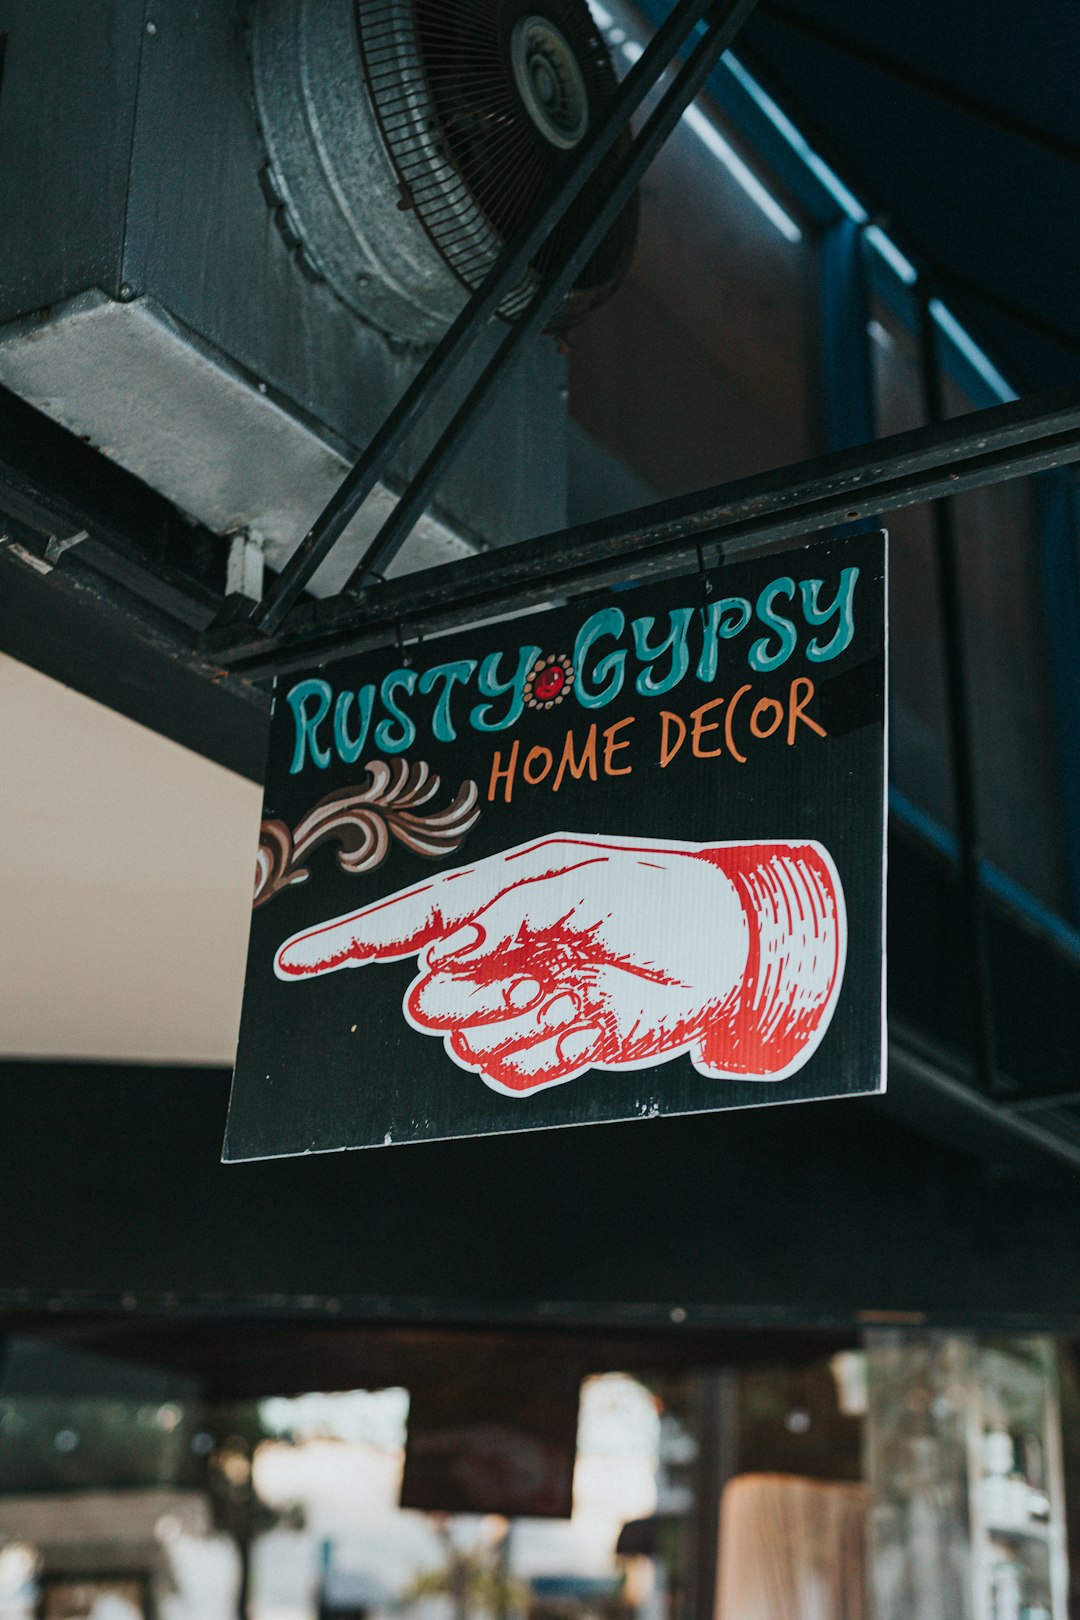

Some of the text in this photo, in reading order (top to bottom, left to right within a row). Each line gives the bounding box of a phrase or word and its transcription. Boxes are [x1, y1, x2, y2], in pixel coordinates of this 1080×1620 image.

[287, 567, 859, 775] RUSTY GYPSY
[488, 677, 827, 802] HOME DECOR
